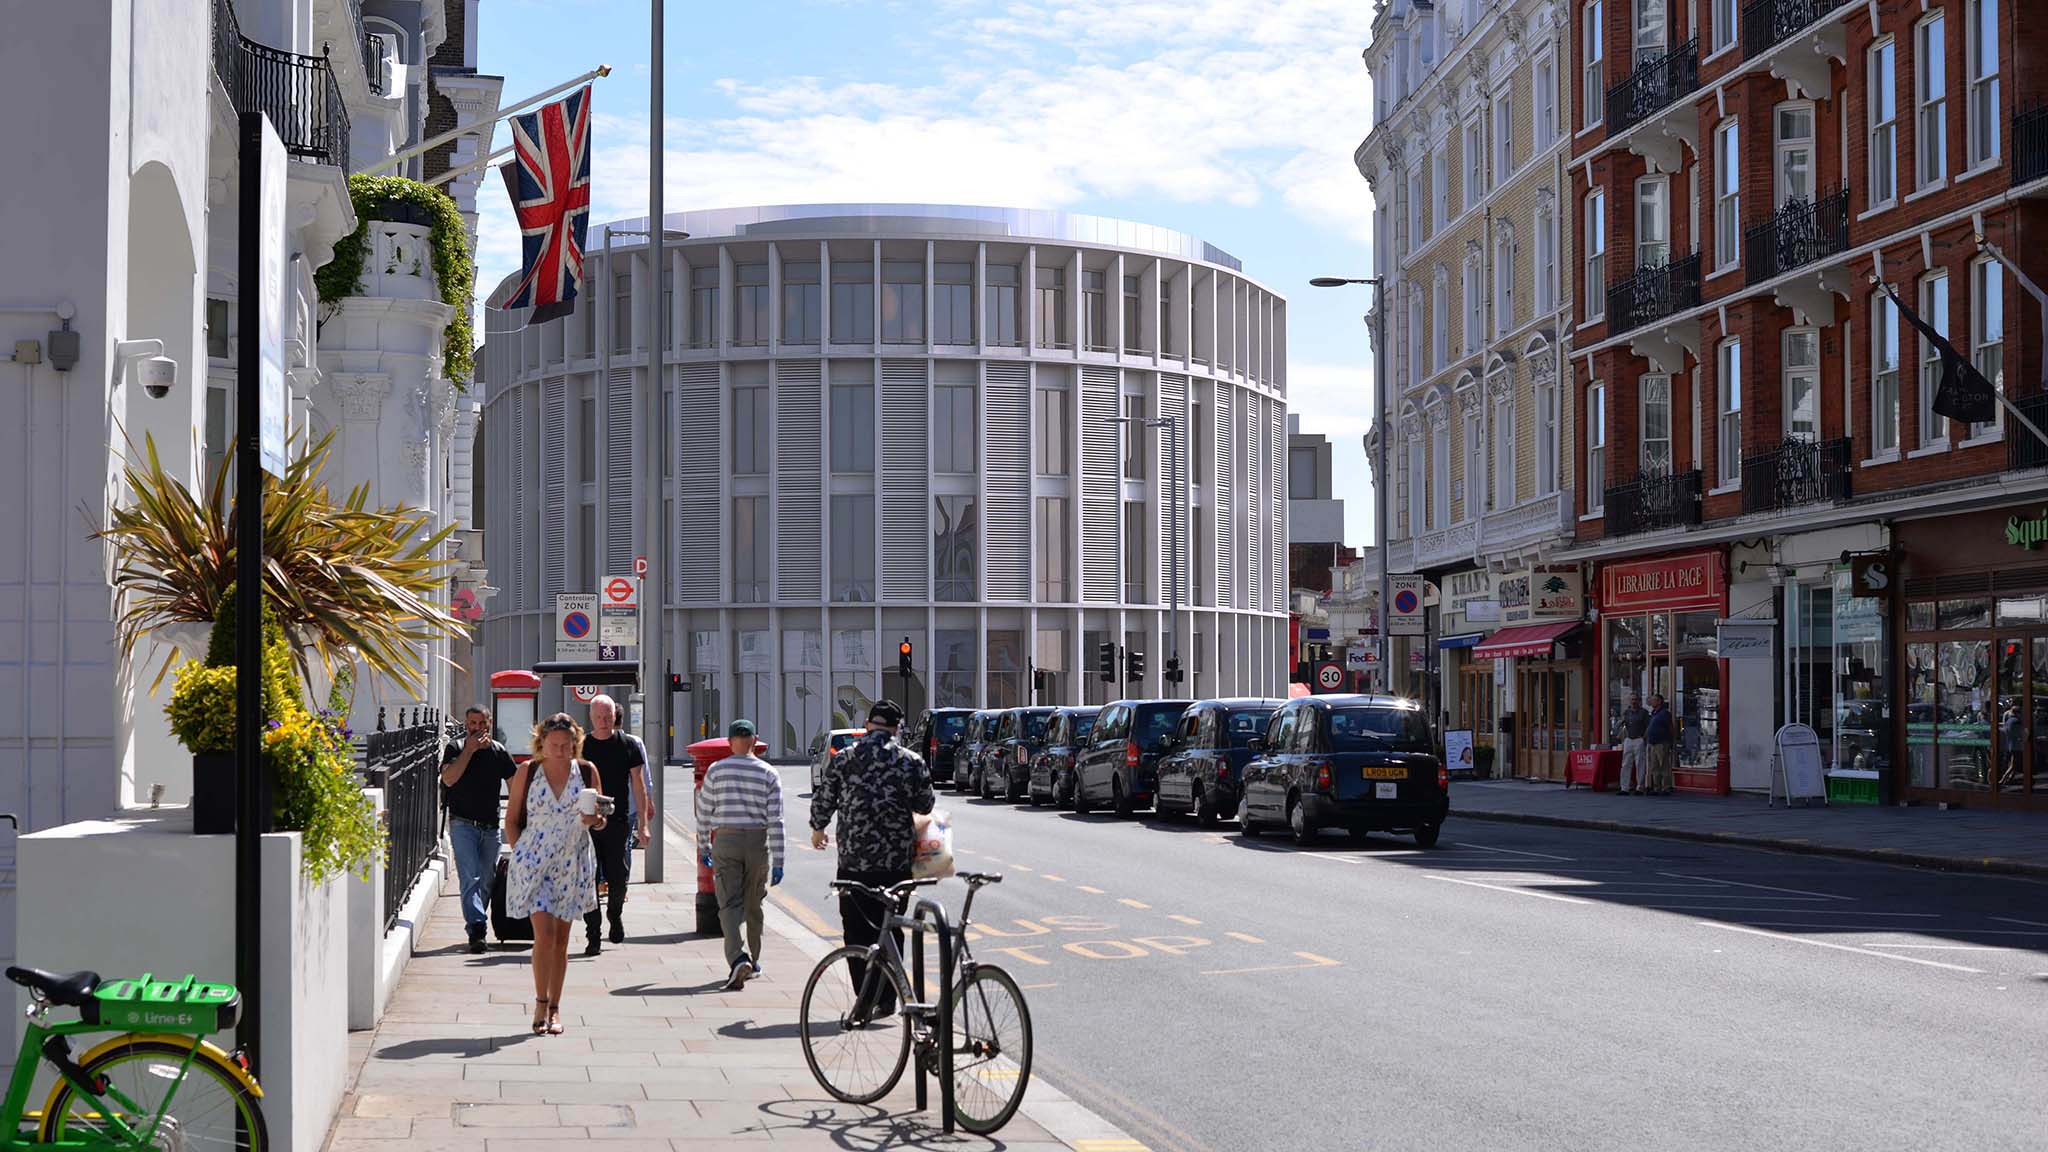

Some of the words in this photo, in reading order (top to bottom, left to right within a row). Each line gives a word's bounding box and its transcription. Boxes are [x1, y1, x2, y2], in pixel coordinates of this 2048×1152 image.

[636, 560, 647, 573] D
[1617, 573, 1661, 594] LIBRAIRIE
[1664, 571, 1676, 589] LA
[1679, 567, 1702, 587] PAGE
[1861, 562, 1889, 590] S
[564, 602, 590, 610] ZONE
[1349, 652, 1377, 662] FedEx
[1321, 671, 1340, 682] 30
[577, 685, 596, 695] 30
